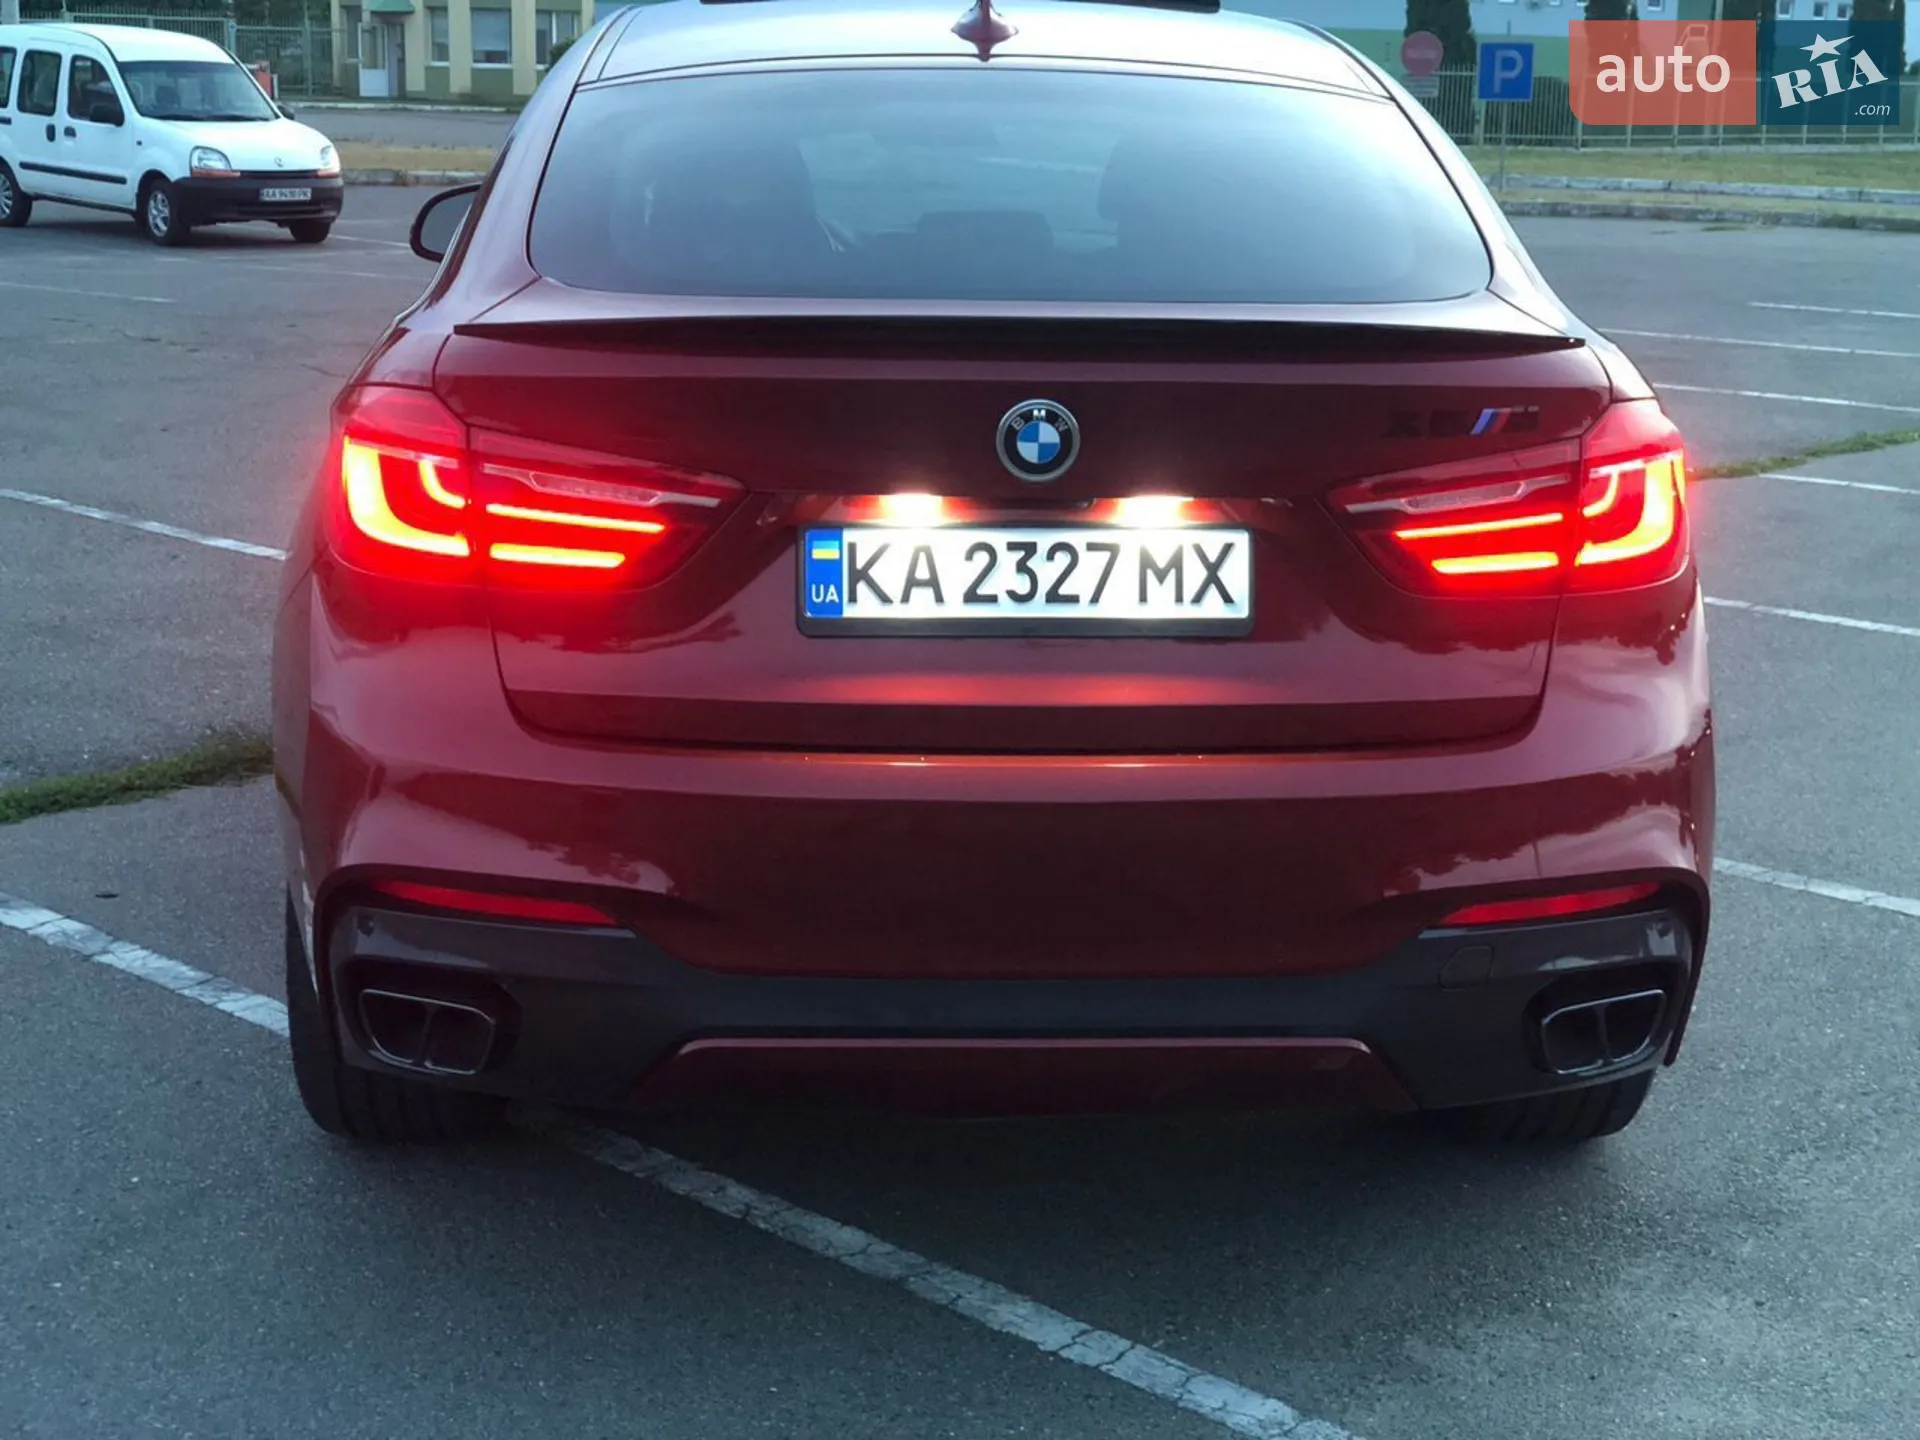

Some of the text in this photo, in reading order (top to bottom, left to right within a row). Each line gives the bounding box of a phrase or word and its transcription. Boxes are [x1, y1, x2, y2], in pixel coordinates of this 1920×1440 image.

[1493, 49, 1524, 94] P
[1010, 408, 1069, 432] BMW
[846, 541, 1236, 605] KA 2327 MX
[811, 583, 840, 604] UA
